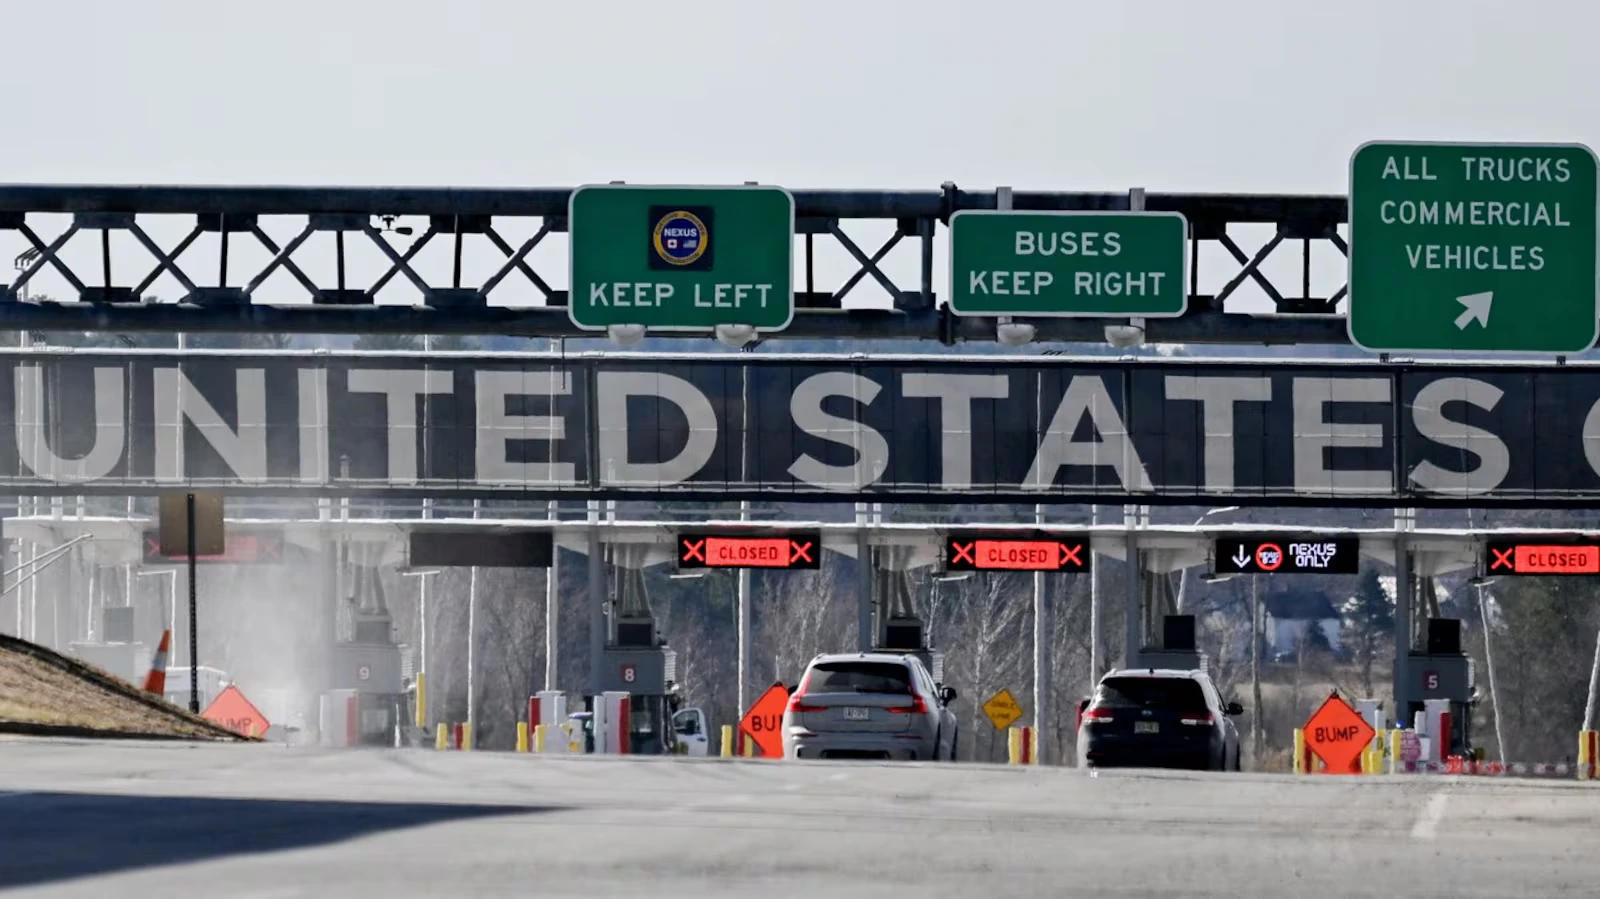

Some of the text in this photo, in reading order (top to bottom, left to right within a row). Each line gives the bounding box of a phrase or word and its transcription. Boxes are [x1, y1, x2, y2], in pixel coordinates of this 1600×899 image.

[1381, 156, 1571, 182] ALL TRUCKS
[1380, 200, 1570, 226] COMMERCIAL
[664, 228, 697, 237] NEXUS
[1015, 231, 1121, 256] BUSES
[1405, 245, 1545, 270] VEHICLES
[969, 270, 1165, 296] KEEP RIGHT
[590, 282, 772, 308] KEEP LEFT
[13, 366, 718, 486] UNITED
[786, 373, 1510, 496] STATES
[720, 546, 778, 560] CLOSED
[988, 549, 1048, 563] CLOSED
[1289, 543, 1336, 556] NEXUS
[1295, 555, 1331, 568] ONLY
[1528, 553, 1587, 567] CLOSED
[360, 667, 369, 680] 9
[625, 668, 635, 682] 8
[1429, 675, 1438, 689] 5
[1315, 726, 1359, 742] BUMP
